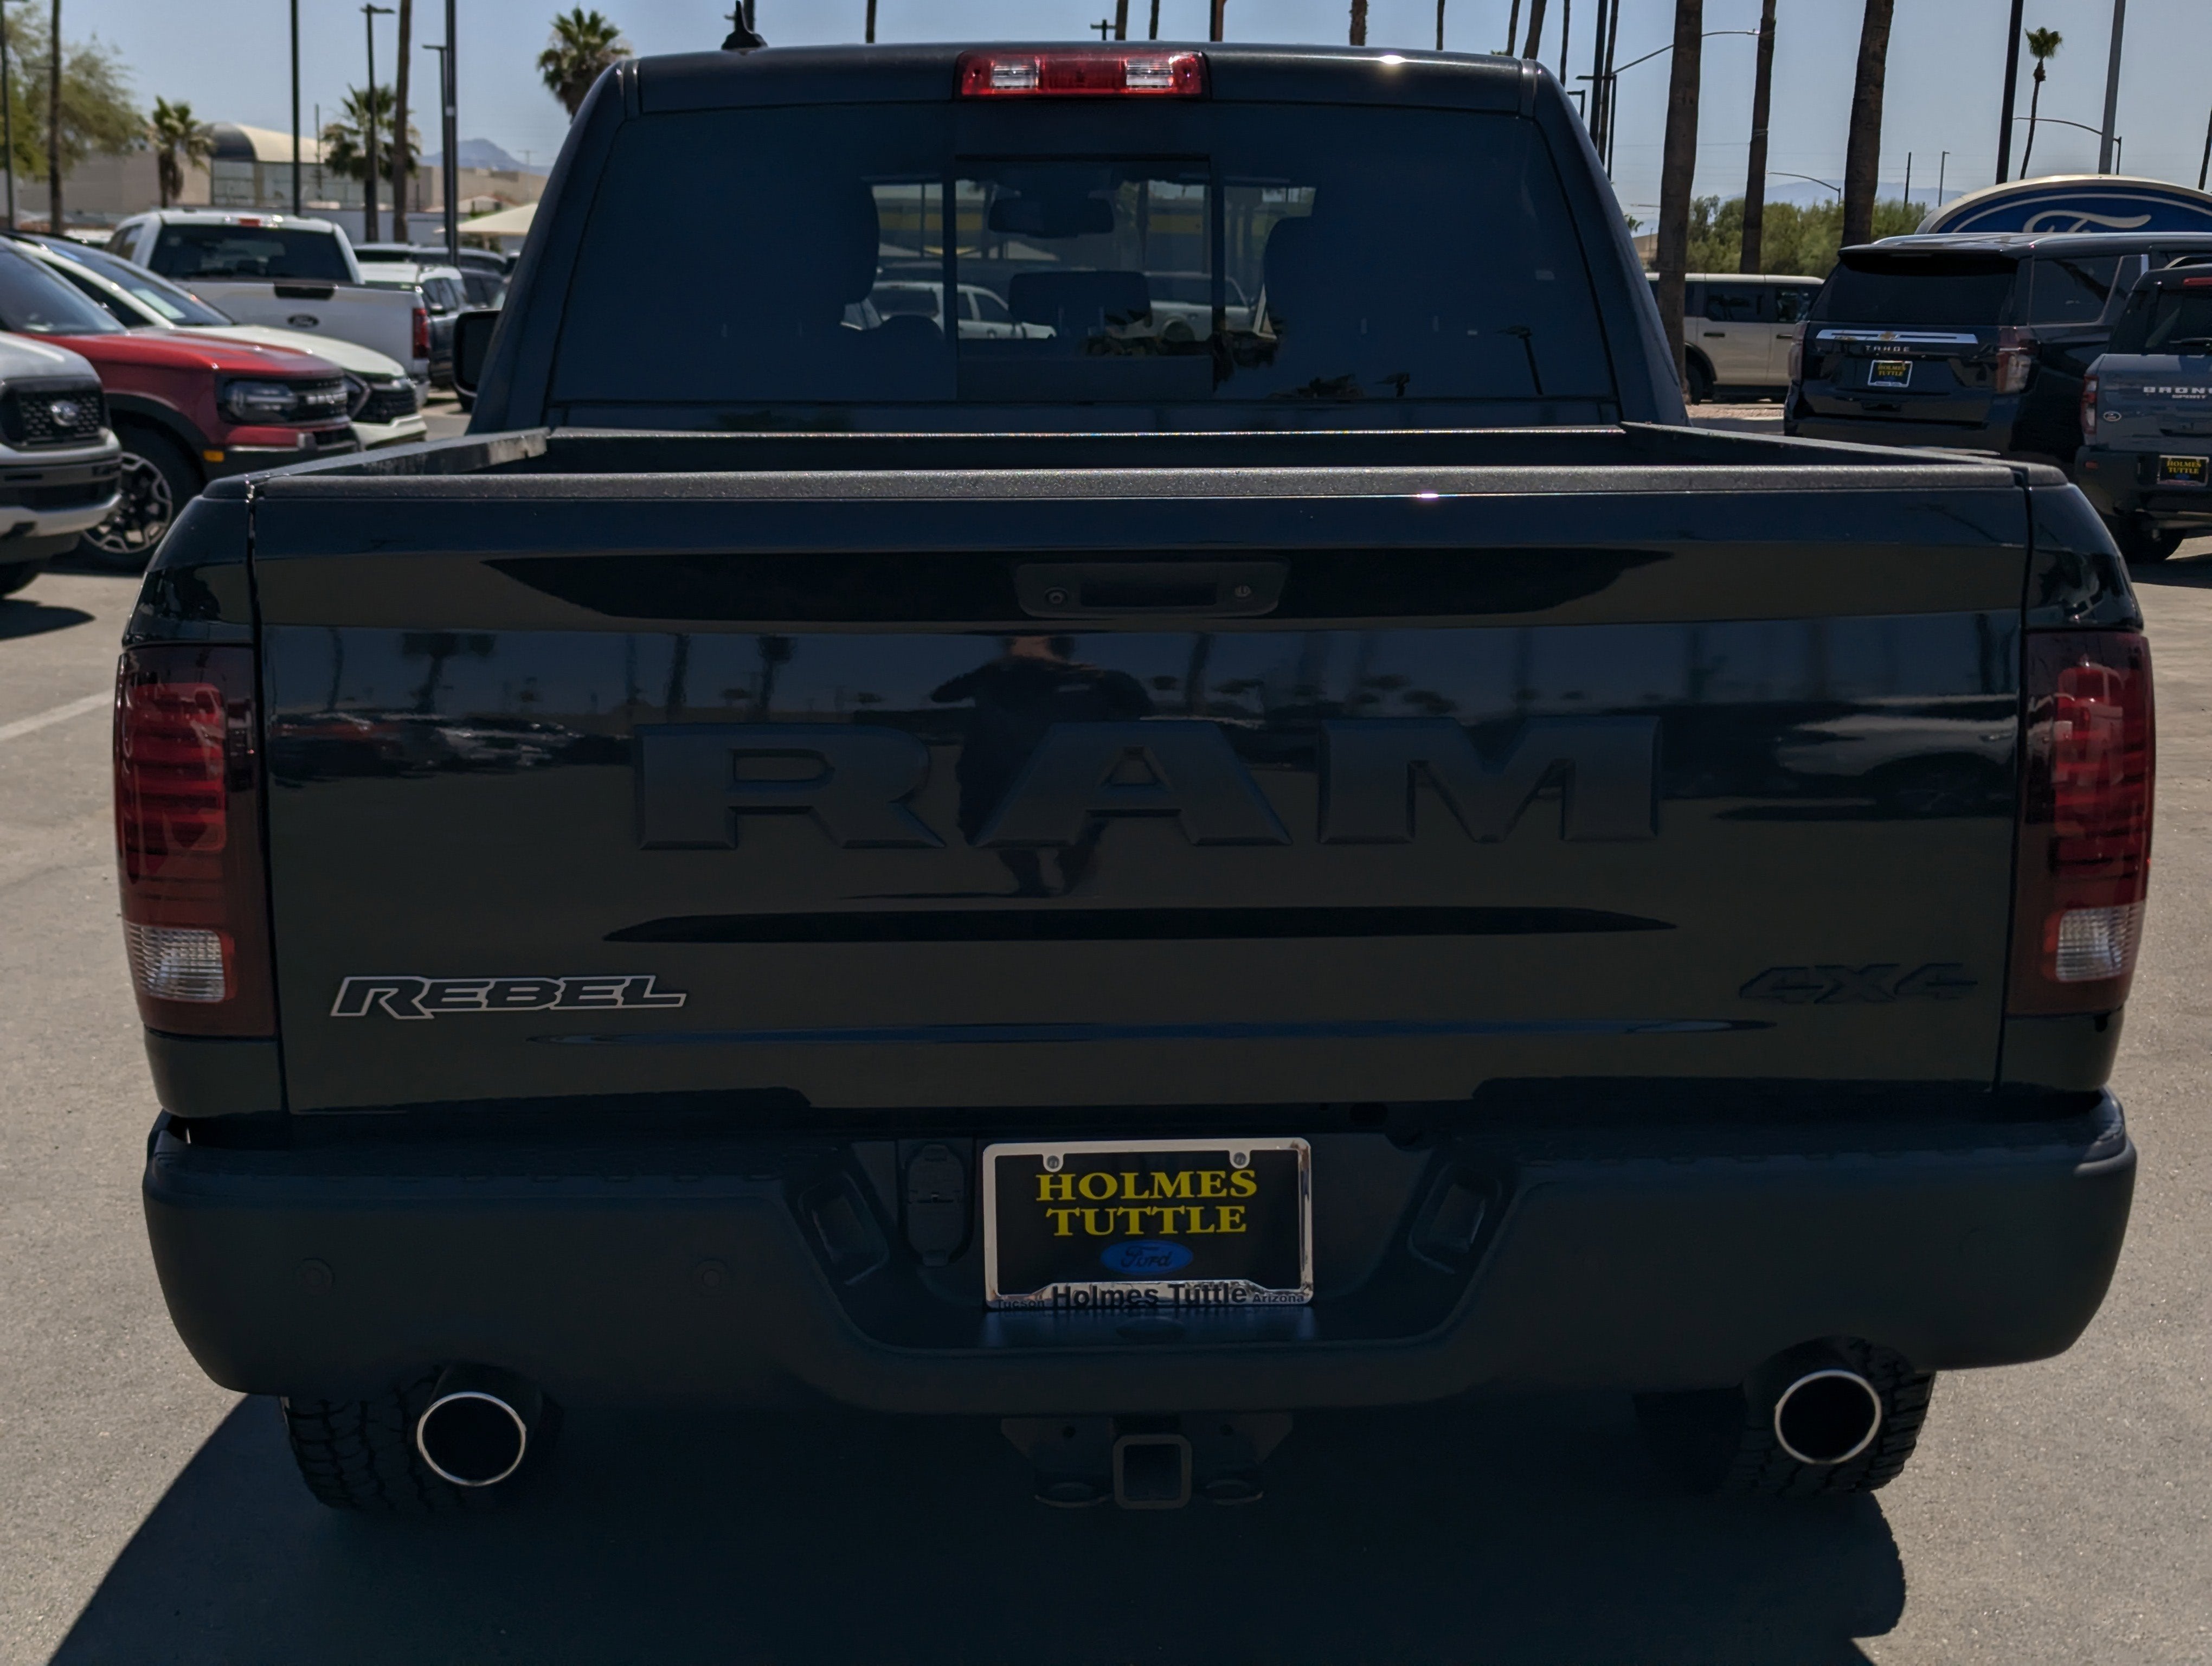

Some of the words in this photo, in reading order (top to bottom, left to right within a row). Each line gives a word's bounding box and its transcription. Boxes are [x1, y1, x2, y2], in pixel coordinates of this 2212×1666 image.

[634, 716, 1661, 850] RAM
[330, 975, 687, 1019] REBEL
[1036, 1169, 1258, 1201] HOLMES
[1045, 1204, 1247, 1236] TUTTLE
[1120, 1244, 1173, 1268] Ford
[998, 1299, 1045, 1309] Tucson
[1053, 1284, 1159, 1308] Holmes
[1167, 1283, 1247, 1304] Tuttle
[1252, 1293, 1304, 1303] Arizona
